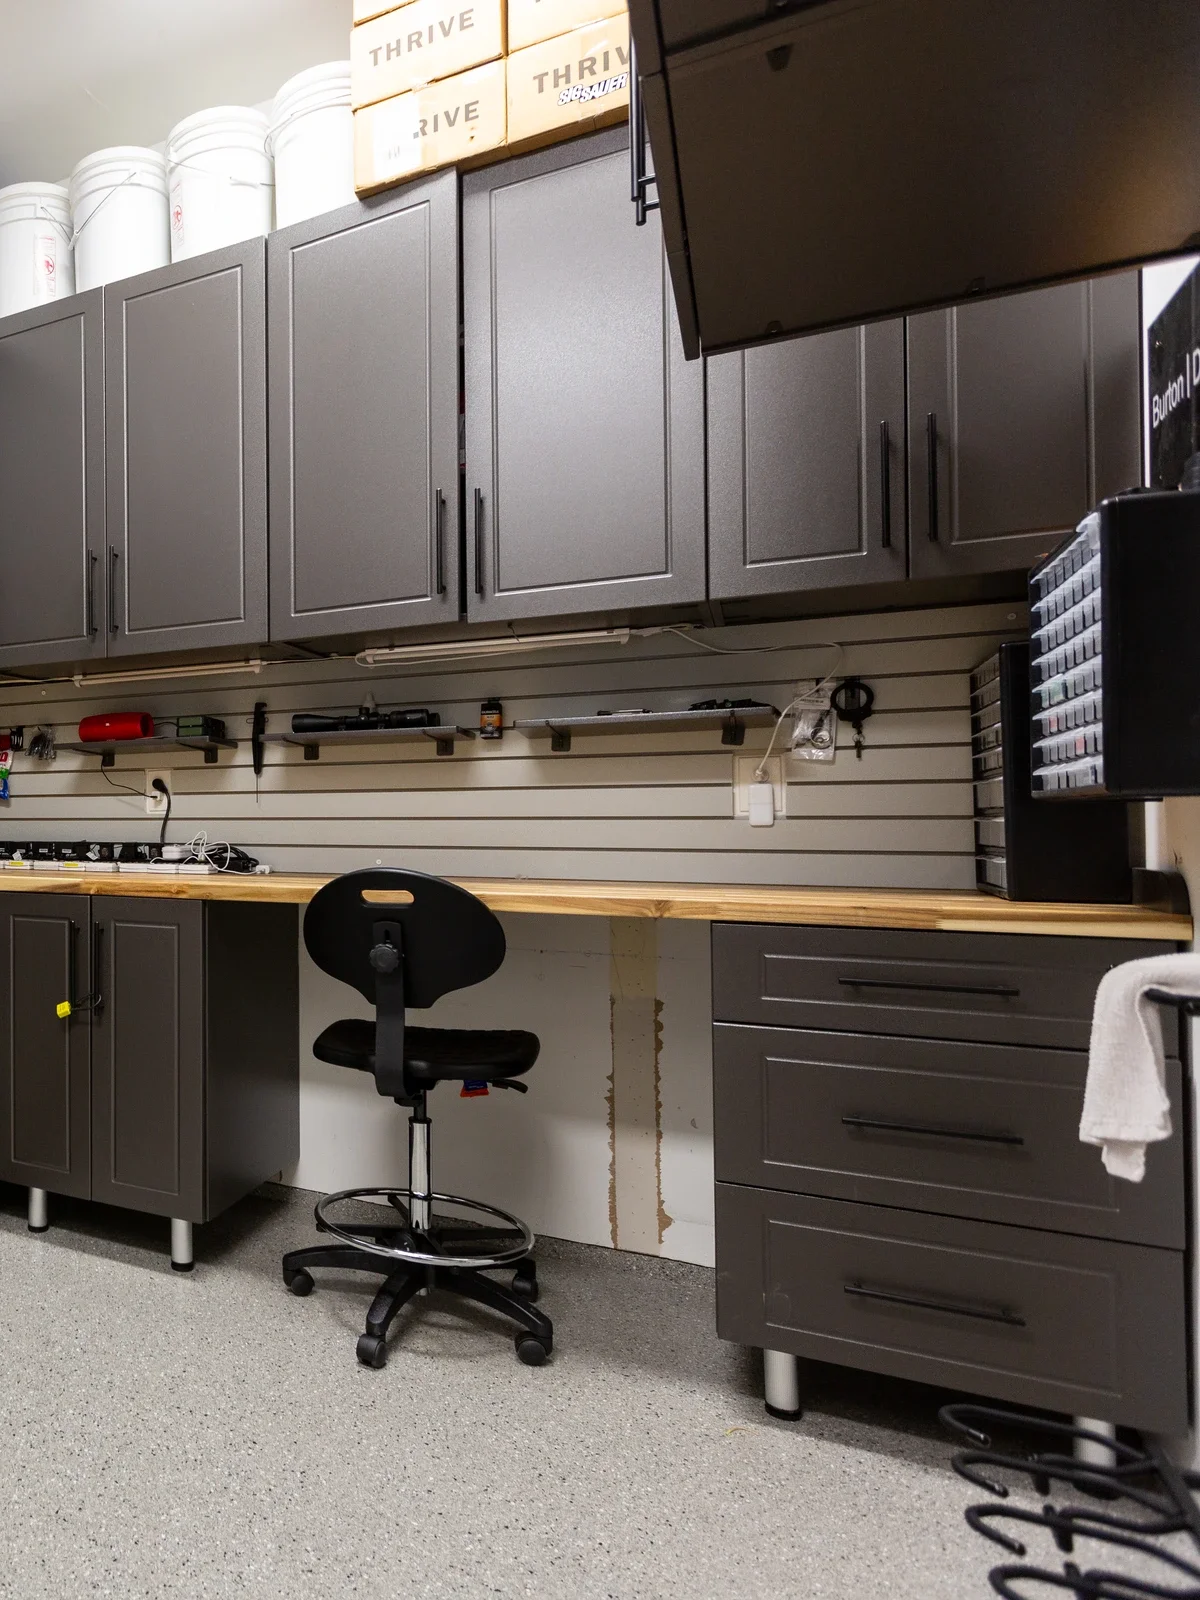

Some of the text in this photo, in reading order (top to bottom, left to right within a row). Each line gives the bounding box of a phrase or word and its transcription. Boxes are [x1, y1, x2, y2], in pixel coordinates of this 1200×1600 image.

[369, 8, 475, 67] THRIVE
[533, 46, 629, 94] THRIV
[557, 71, 629, 106] SIG SAUER
[413, 100, 480, 139] RIVE
[1152, 374, 1184, 429] Burton
